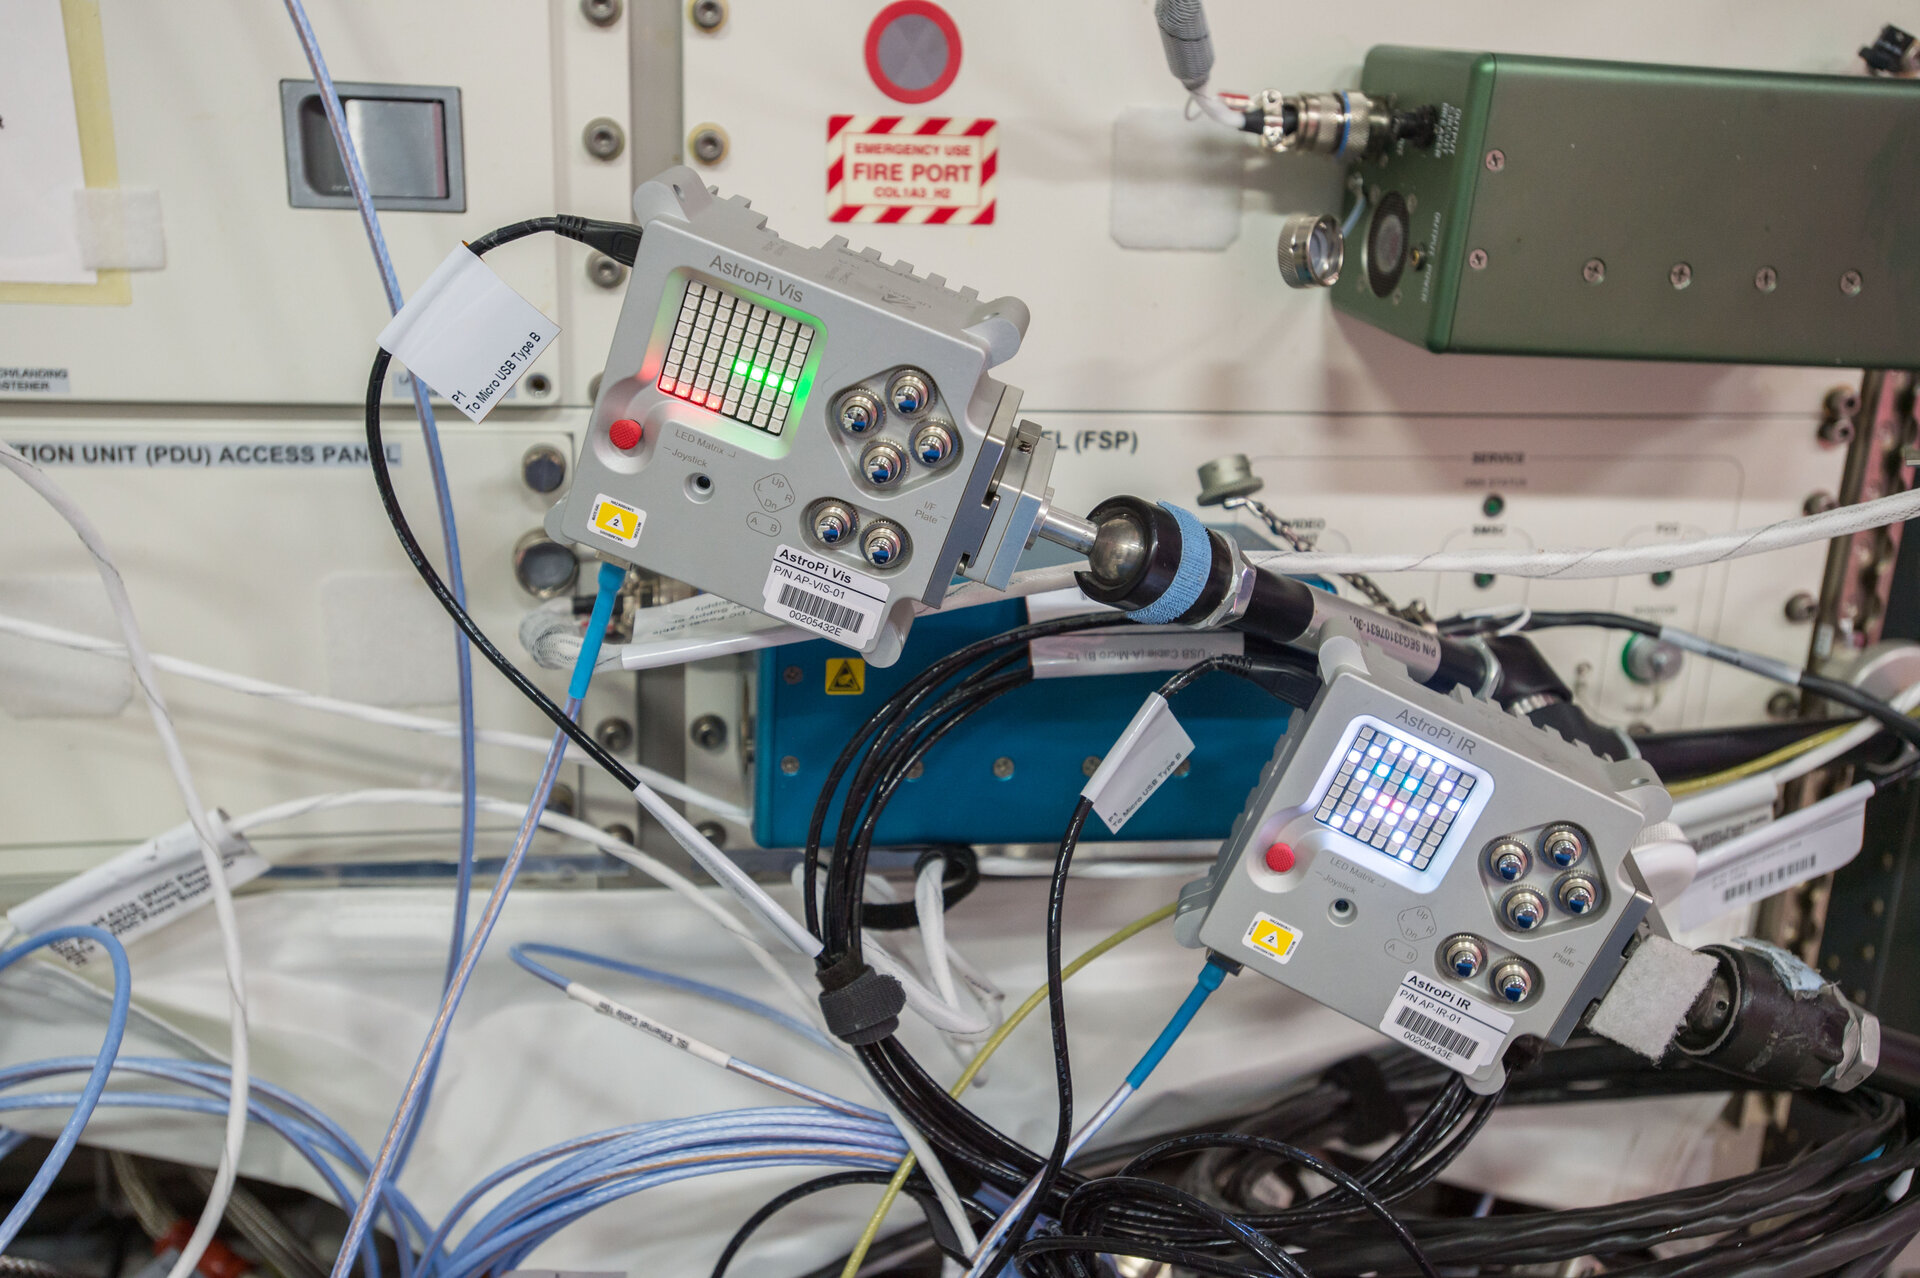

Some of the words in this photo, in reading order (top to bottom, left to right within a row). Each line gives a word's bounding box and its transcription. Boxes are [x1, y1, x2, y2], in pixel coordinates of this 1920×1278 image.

[854, 142, 940, 156] EMERGENCY
[944, 145, 971, 156] USE
[853, 163, 903, 181] FIRE
[911, 164, 973, 182] PORT
[709, 254, 775, 291] AstroPi
[777, 278, 803, 303] Vis
[465, 398, 481, 415] To
[475, 379, 501, 404] Micro
[494, 359, 517, 381] USB
[511, 339, 535, 363] Type
[528, 331, 542, 343] B
[451, 389, 467, 405] P1
[675, 429, 695, 443] LED
[697, 438, 725, 454] Matrix
[1075, 430, 1138, 454] (FSP)
[83, 445, 136, 463] UNIT
[146, 444, 211, 467] (PDU)
[219, 446, 315, 464] ACCESS
[322, 447, 399, 464] PANL
[672, 448, 708, 468] Joystick
[771, 477, 785, 489] Up
[764, 498, 777, 510] Dn
[785, 494, 793, 503] R
[923, 500, 937, 512] I/F
[613, 518, 620, 527] 2
[750, 517, 759, 526] A
[770, 524, 777, 533] B
[914, 509, 939, 525] Plate
[780, 548, 830, 575] AstroPi
[832, 567, 852, 584] Vis
[773, 565, 793, 579] P/N
[794, 572, 846, 600] AP-VIS-01
[789, 610, 843, 637] 00205432E
[1147, 647, 1178, 660] Cable
[1182, 648, 1205, 660] USB
[1422, 642, 1437, 658] P/N
[1395, 708, 1456, 745] AstroPi
[1456, 735, 1477, 755] IR
[1112, 817, 1123, 828] To
[1122, 796, 1142, 817] Micro
[1142, 778, 1158, 796] USB
[1157, 760, 1176, 778] Type
[1108, 812, 1118, 823] P1
[1330, 857, 1349, 871] LED
[1349, 866, 1376, 884] Matrix
[1323, 873, 1357, 895] Joystick
[1416, 909, 1429, 921] Up
[1268, 935, 1275, 943] 2
[1405, 927, 1418, 939] Dn
[1552, 952, 1575, 968] Plate
[1407, 975, 1457, 1003] AstroPi
[1456, 997, 1471, 1011] IR
[1399, 989, 1418, 1004] P/N
[1418, 998, 1463, 1025] AP-IR-01
[1403, 1030, 1455, 1061] 00205433E
